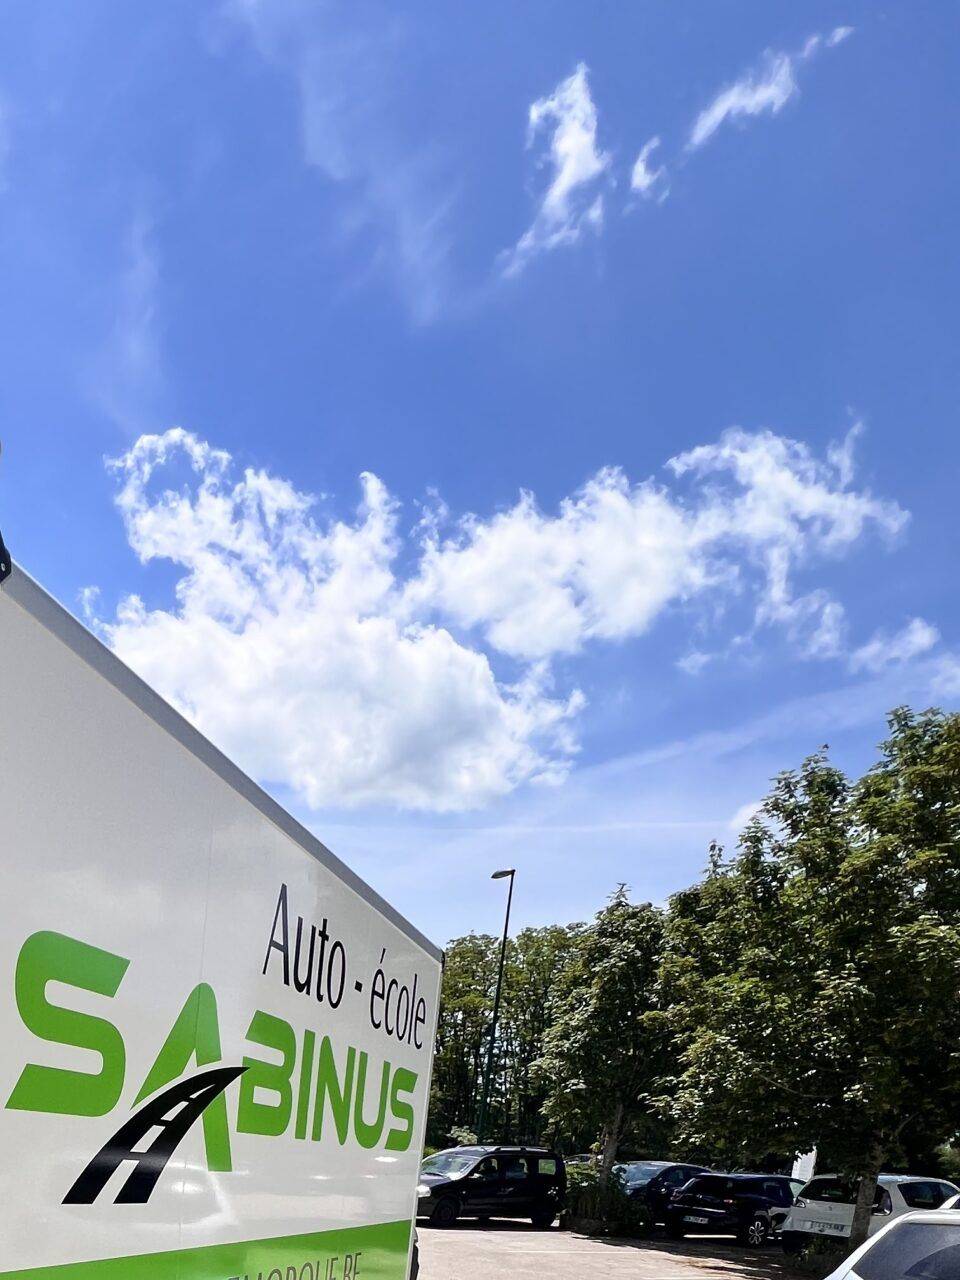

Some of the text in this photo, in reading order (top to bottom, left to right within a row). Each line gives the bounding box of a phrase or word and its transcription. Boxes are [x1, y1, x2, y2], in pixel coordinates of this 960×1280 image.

[5, 929, 419, 1172] SABINUS
[262, 882, 346, 1010] Auto
[369, 947, 427, 1050] école
